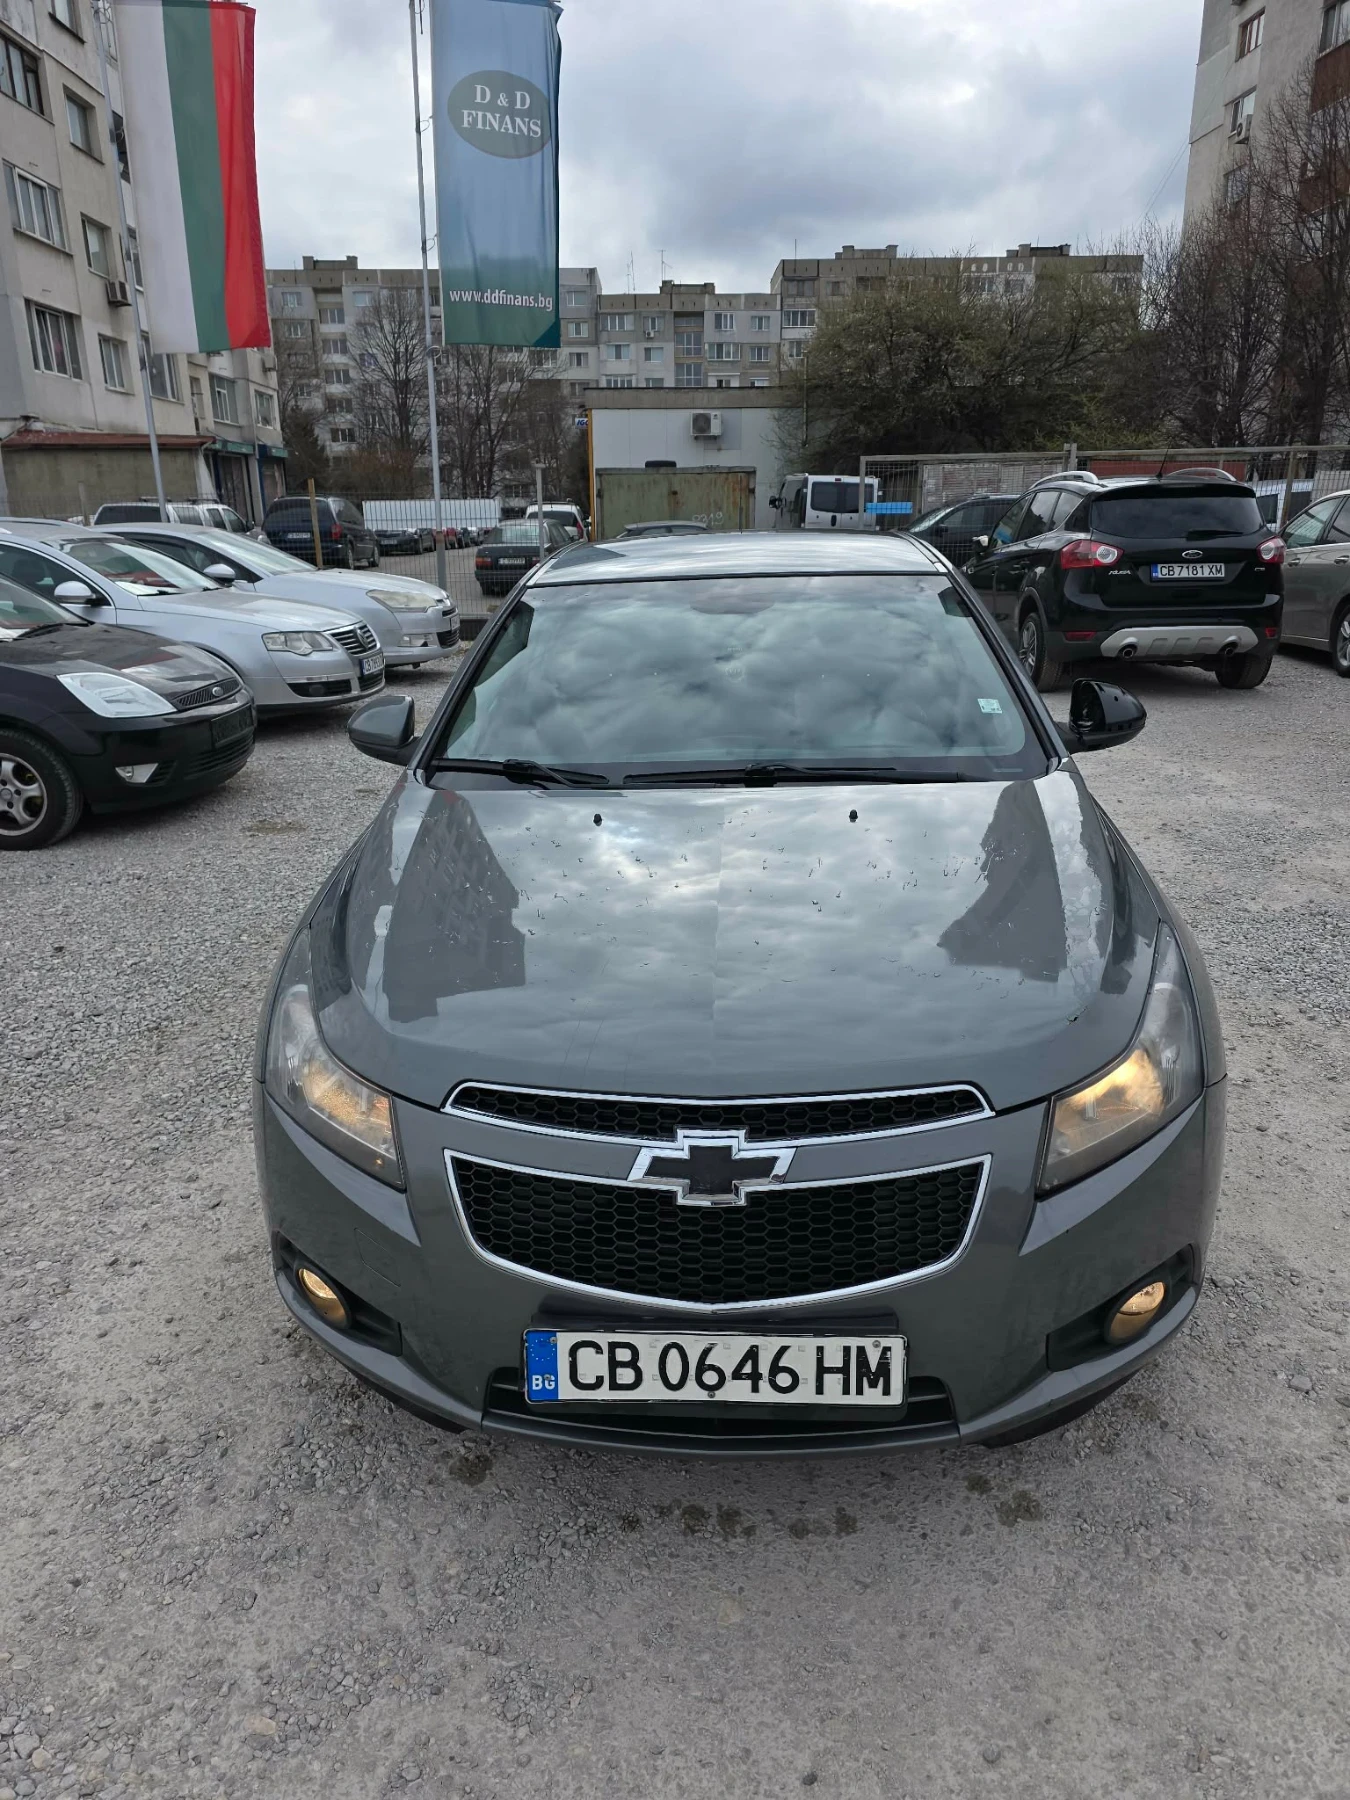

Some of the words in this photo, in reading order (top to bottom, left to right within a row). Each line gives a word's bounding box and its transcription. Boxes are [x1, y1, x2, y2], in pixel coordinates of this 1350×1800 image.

[474, 84, 491, 104] D
[497, 92, 509, 107] &
[514, 91, 531, 110] D
[461, 109, 542, 138] FINANS
[450, 289, 553, 311] www.ddfinans.bg
[1160, 565, 1175, 577] CB
[1177, 564, 1205, 577] 7181
[1207, 564, 1223, 576] XM
[568, 1339, 643, 1392] CB
[658, 1341, 800, 1395] 0646
[815, 1344, 892, 1396] HM
[532, 1374, 556, 1390] BG
